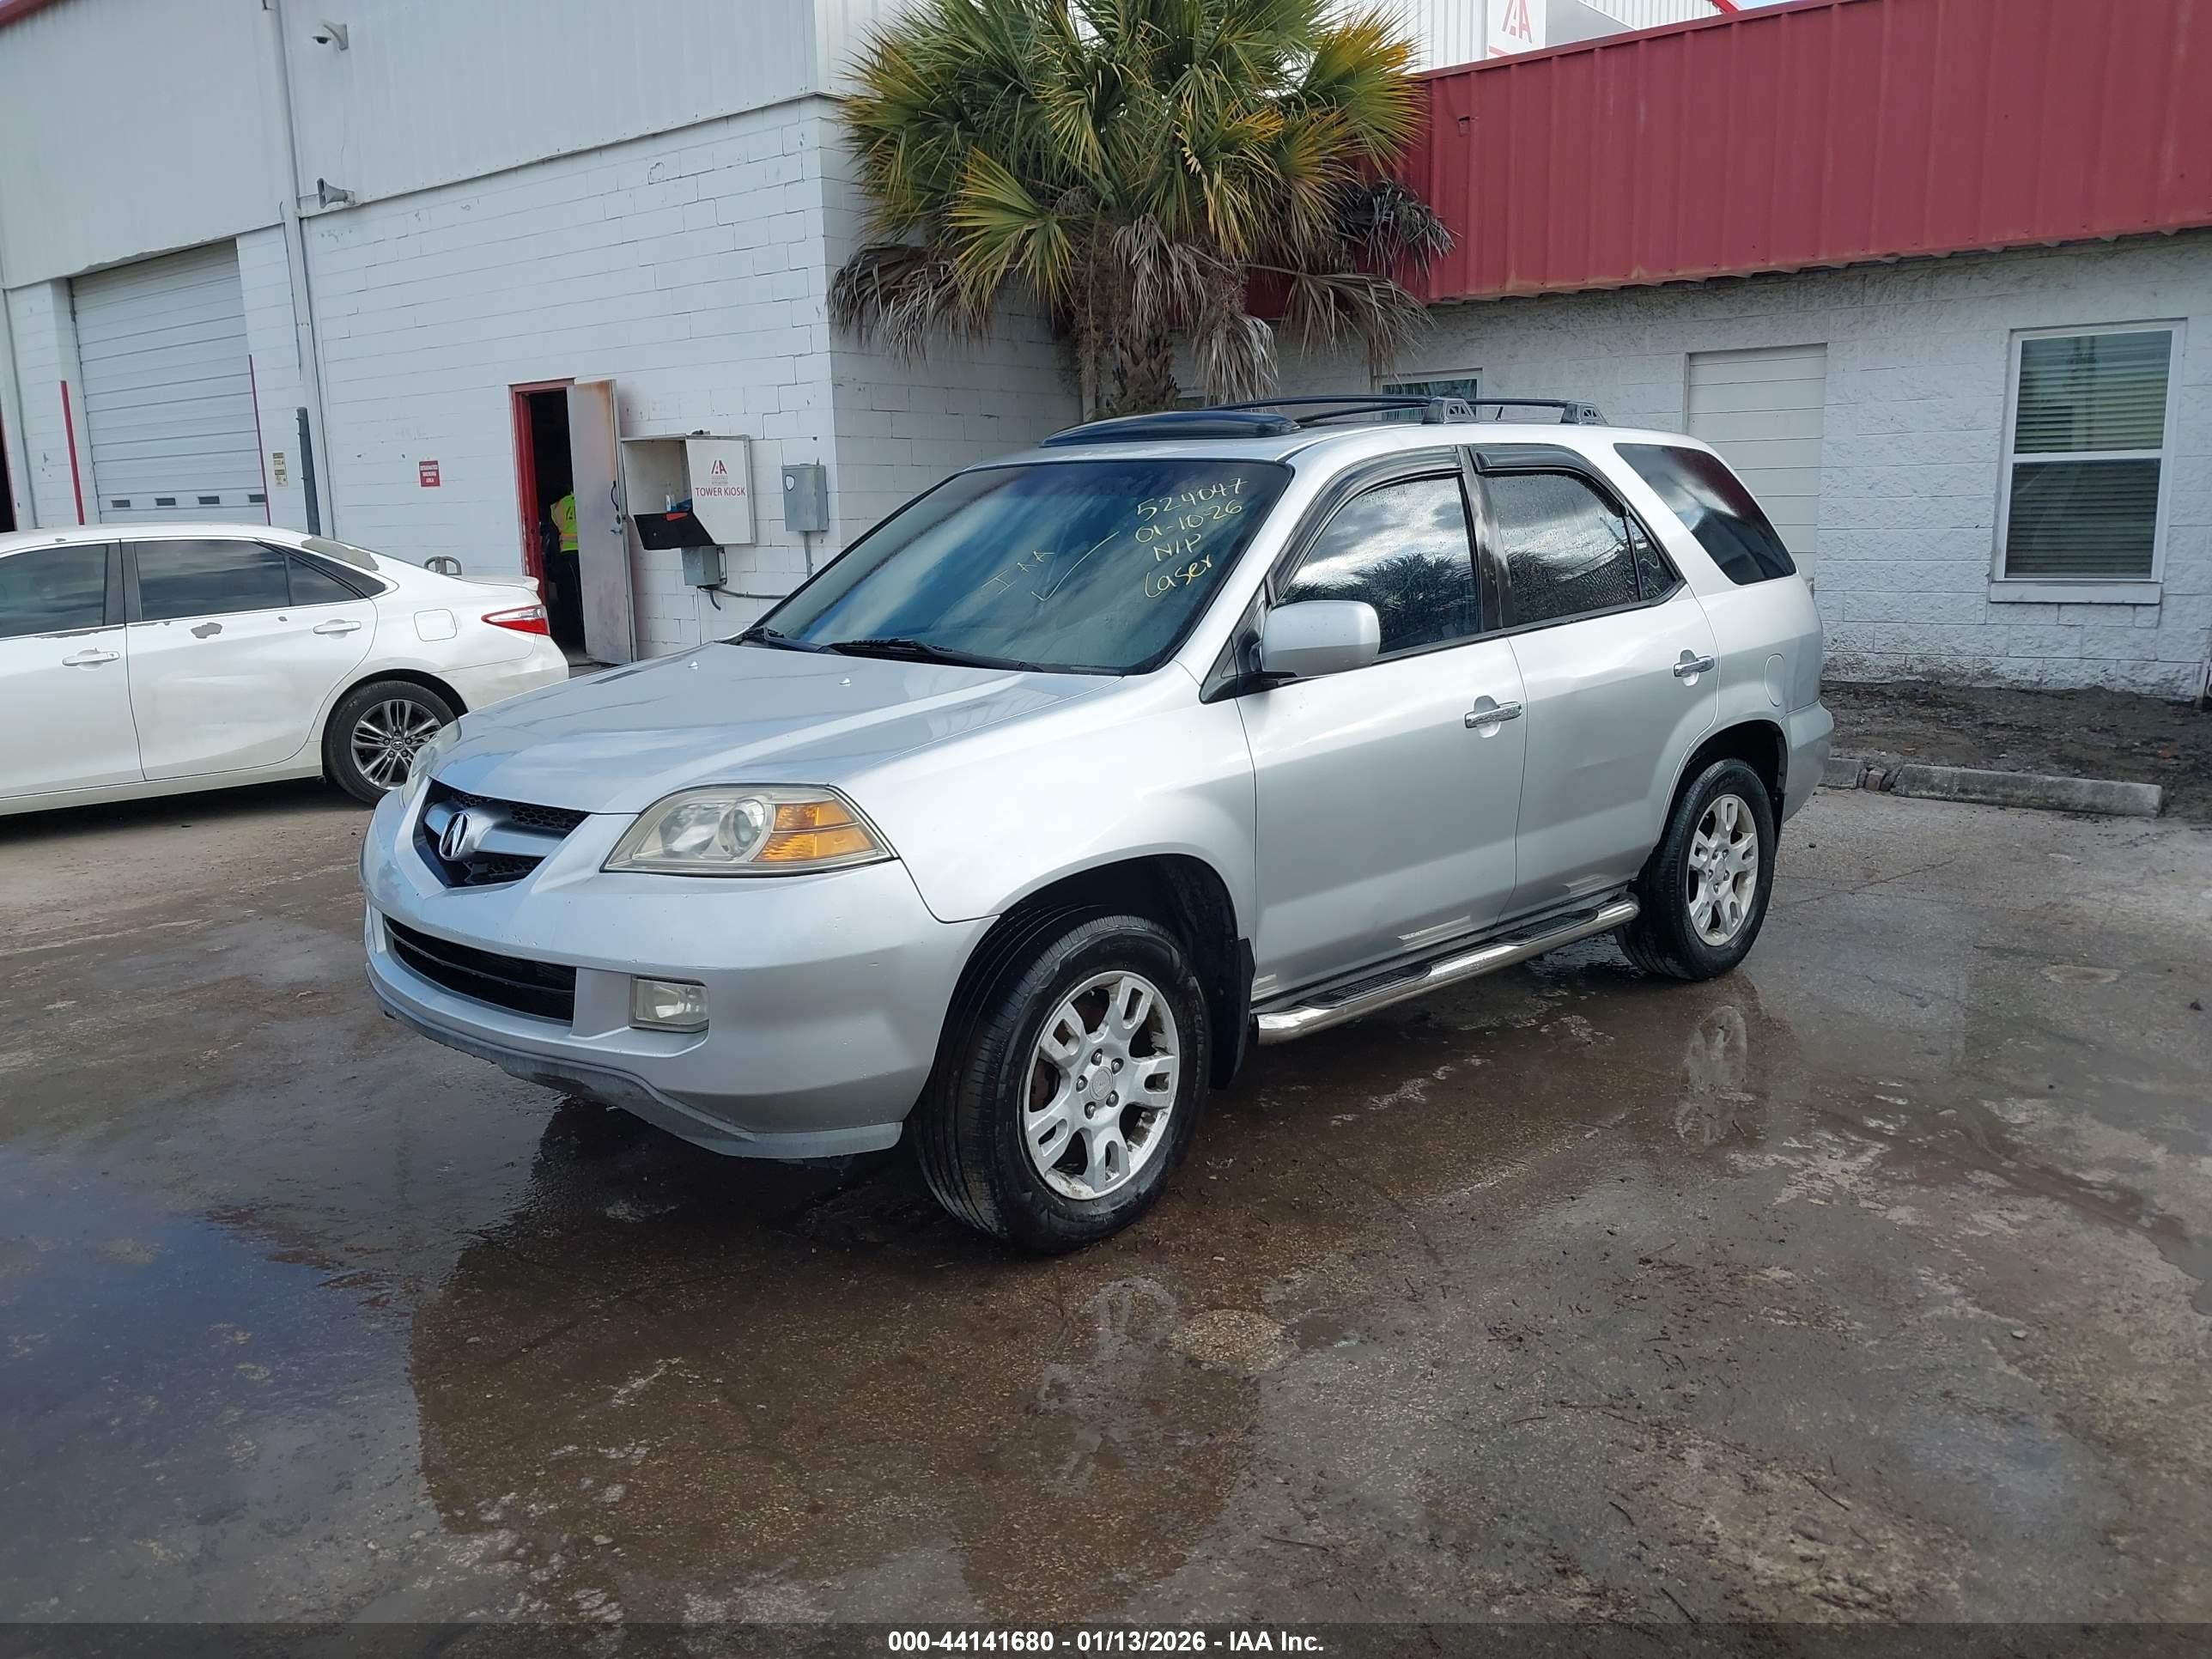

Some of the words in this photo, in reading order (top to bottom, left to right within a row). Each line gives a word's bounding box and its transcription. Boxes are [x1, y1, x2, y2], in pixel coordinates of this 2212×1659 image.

[695, 487, 722, 497] TOWER
[724, 487, 746, 496] KIOSK
[1137, 477, 1250, 522] 524047
